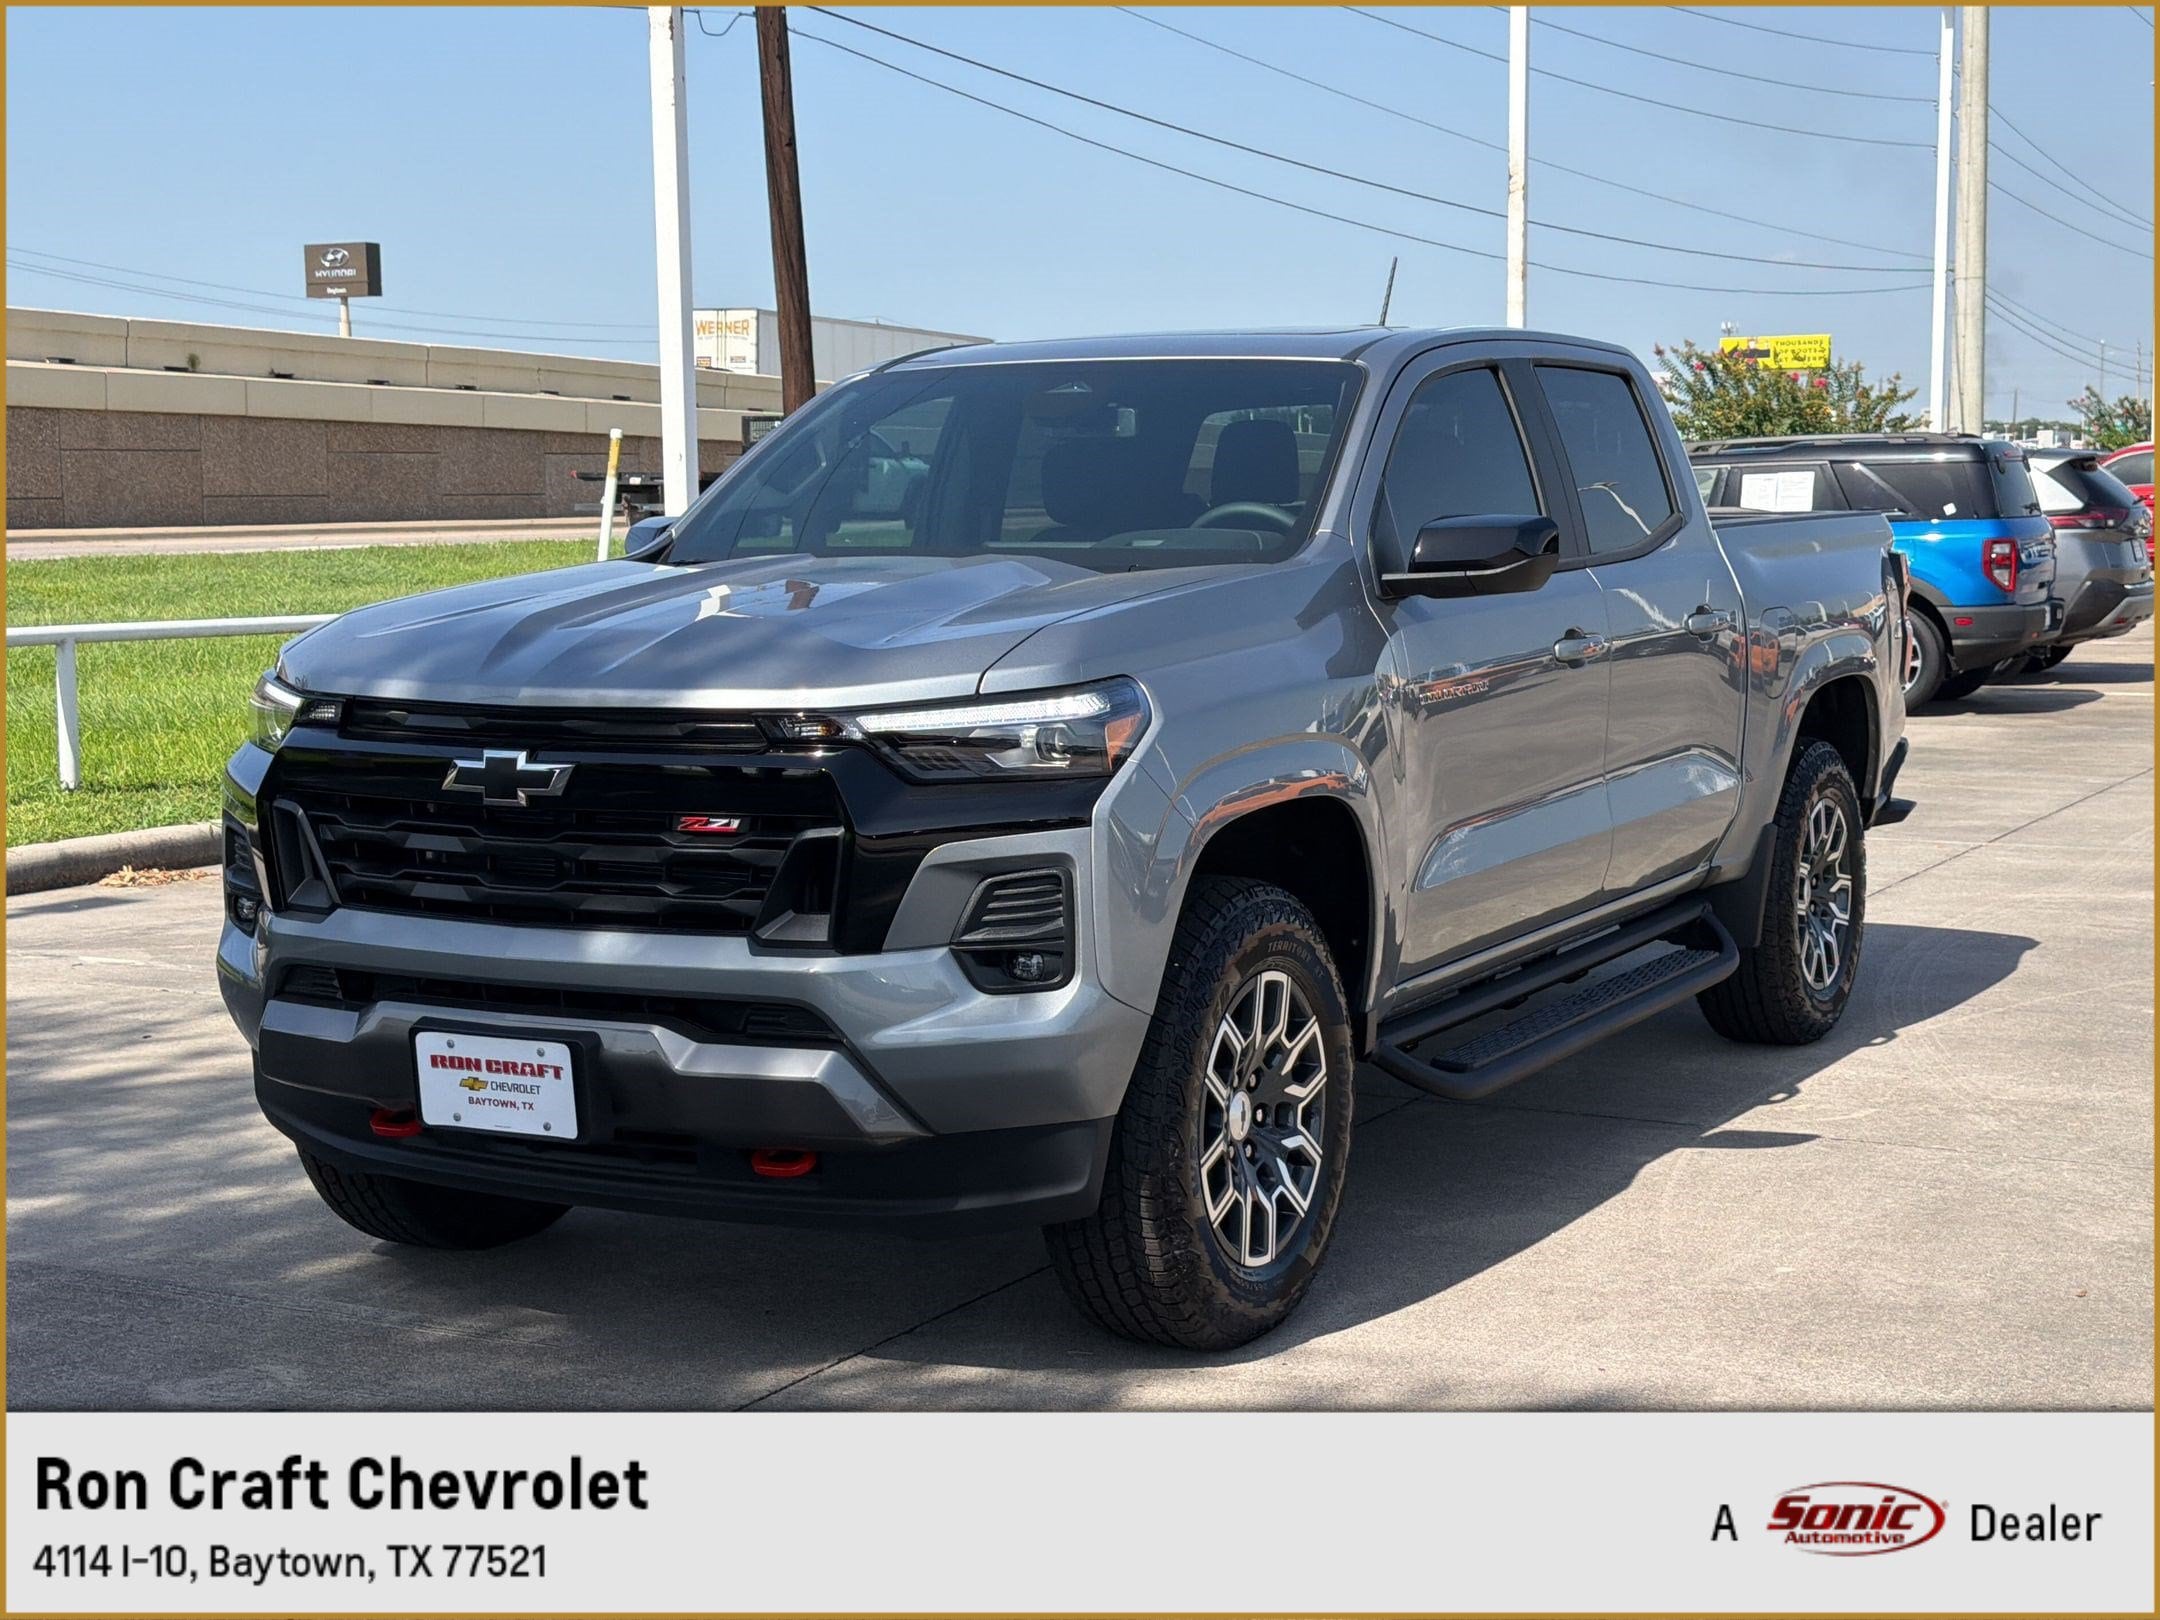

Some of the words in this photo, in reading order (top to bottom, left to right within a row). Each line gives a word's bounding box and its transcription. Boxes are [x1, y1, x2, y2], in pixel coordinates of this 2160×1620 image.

[314, 269, 357, 278] HYUNDAI
[695, 319, 749, 336] WERNER
[678, 816, 741, 833] Z71
[1267, 940, 1312, 962] TERRITORY
[430, 1054, 482, 1073] RON
[485, 1059, 564, 1080] CRAFT
[490, 1080, 541, 1095] CHEVROLET
[468, 1096, 519, 1111] BAYTOWN,
[521, 1101, 535, 1111] TX
